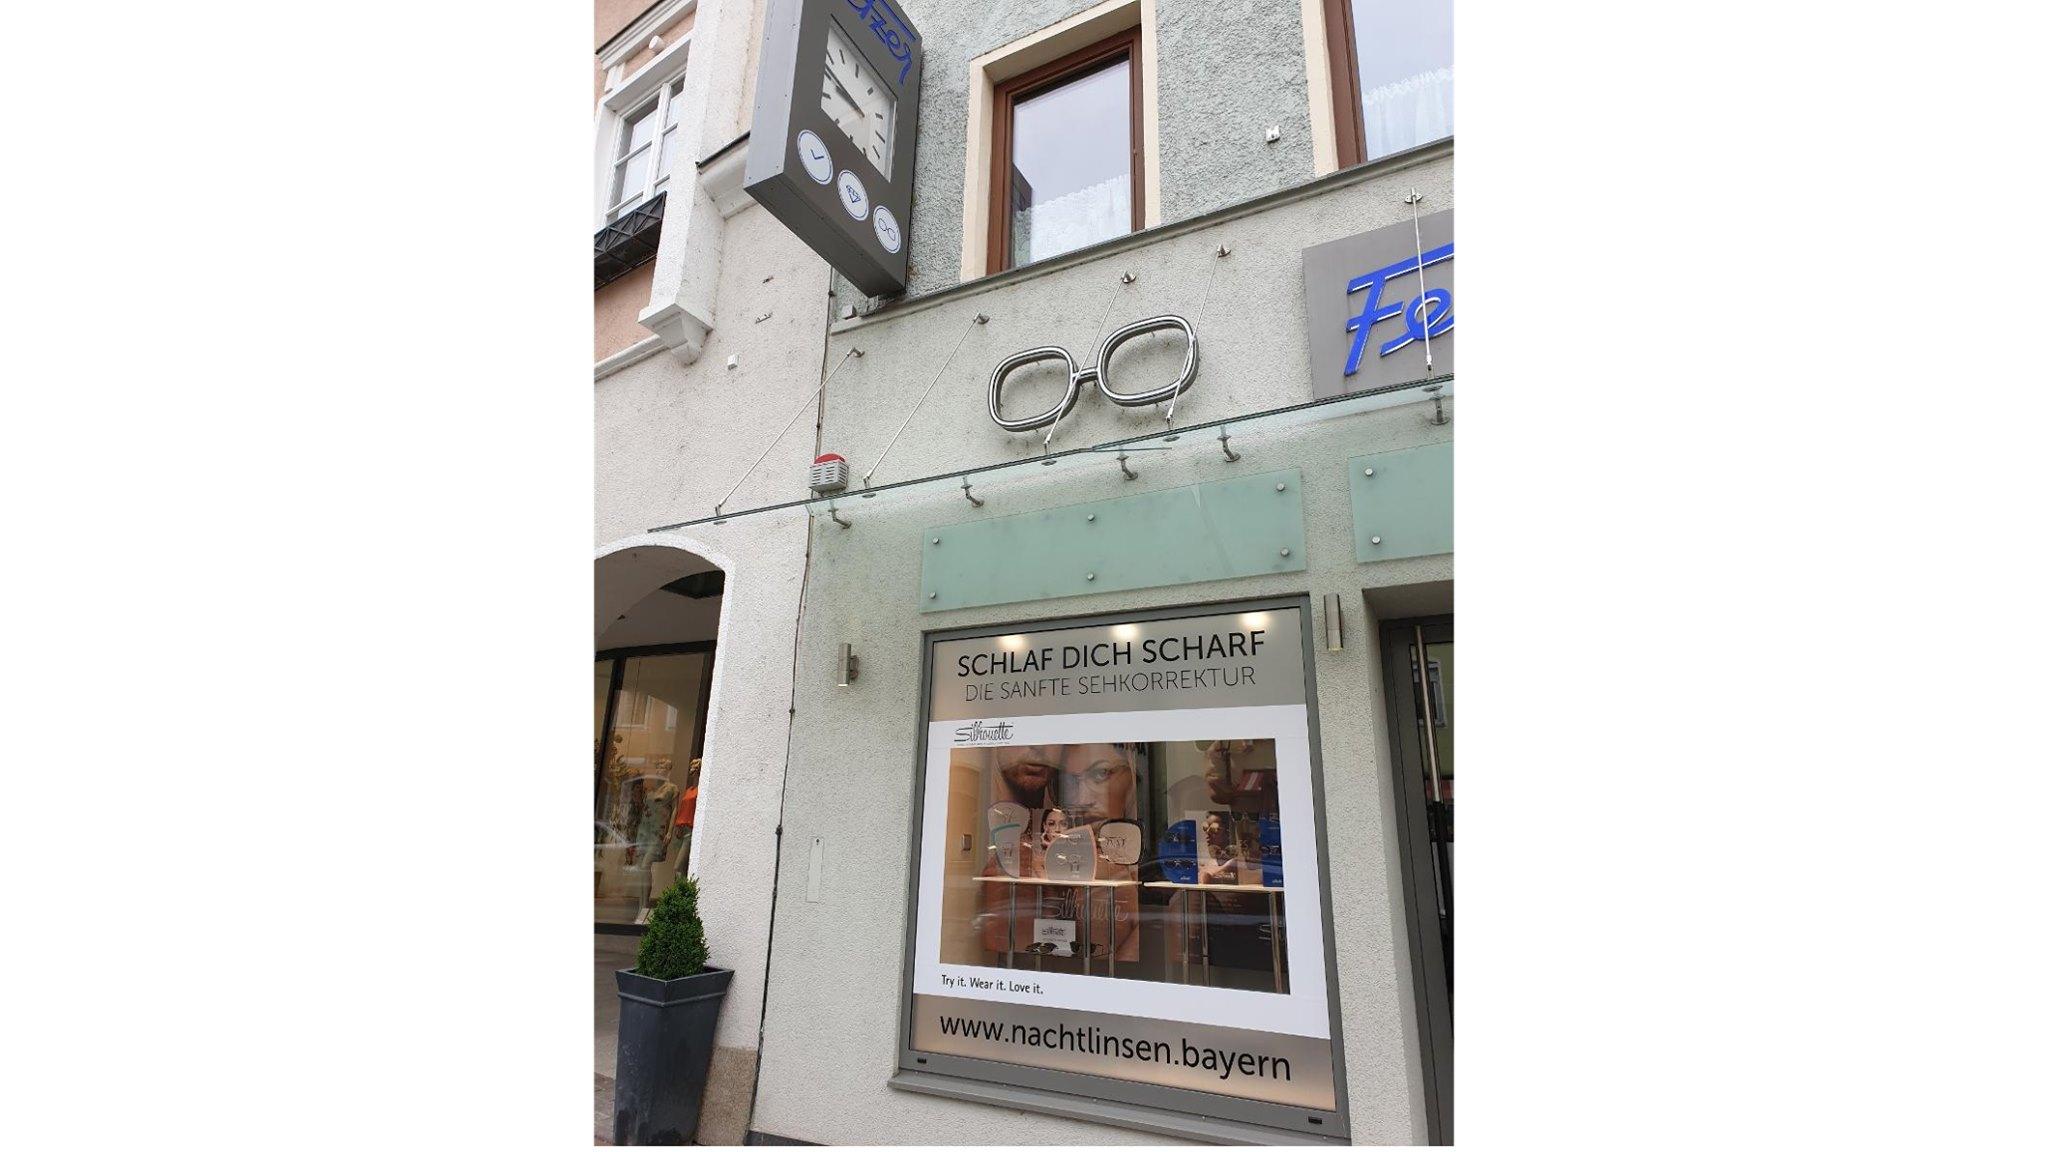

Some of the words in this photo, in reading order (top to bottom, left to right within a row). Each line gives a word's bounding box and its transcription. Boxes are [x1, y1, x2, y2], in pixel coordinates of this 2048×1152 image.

[957, 648, 1053, 677] SCHLAF
[1062, 641, 1131, 669] DICH
[1142, 630, 1265, 663] SCHARF
[966, 683, 993, 701] DIE
[1000, 677, 1071, 700] SANFTE
[1078, 666, 1256, 695] SEHKORREKTUR
[954, 720, 1013, 742] Silhouette
[941, 974, 955, 989] Try
[957, 976, 967, 988] it.
[970, 977, 994, 990] Wear
[996, 979, 1006, 991] it.
[1009, 980, 1030, 994] Love
[1033, 982, 1044, 995] it.
[939, 1014, 1292, 1082] www.nachtlinsen.bayern
